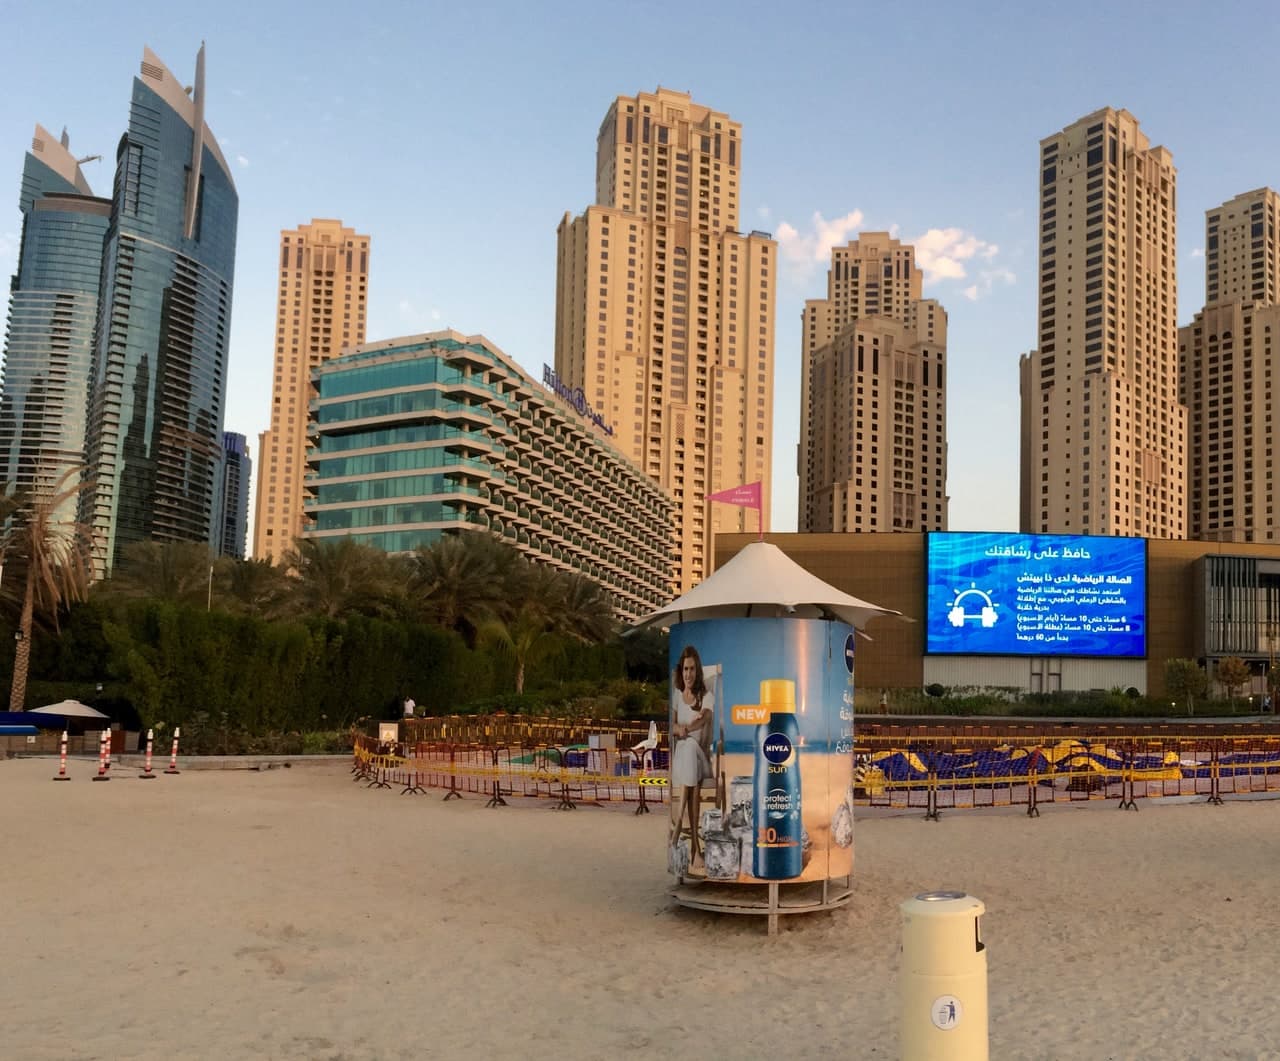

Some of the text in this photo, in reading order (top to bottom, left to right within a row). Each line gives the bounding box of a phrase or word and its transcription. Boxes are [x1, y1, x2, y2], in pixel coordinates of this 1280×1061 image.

[542, 362, 573, 403] Hilton
[984, 545, 1091, 560] حافظ على رشاقتك
[1044, 573, 1052, 582] ذا
[1053, 573, 1070, 584] لدى
[1071, 574, 1104, 585] الرياضية
[1106, 575, 1132, 584] الصالة
[1121, 615, 1127, 623] 6
[735, 708, 767, 720] NEW
[768, 766, 787, 774] sun
[763, 794, 792, 804] protect
[767, 801, 793, 810] refresh
